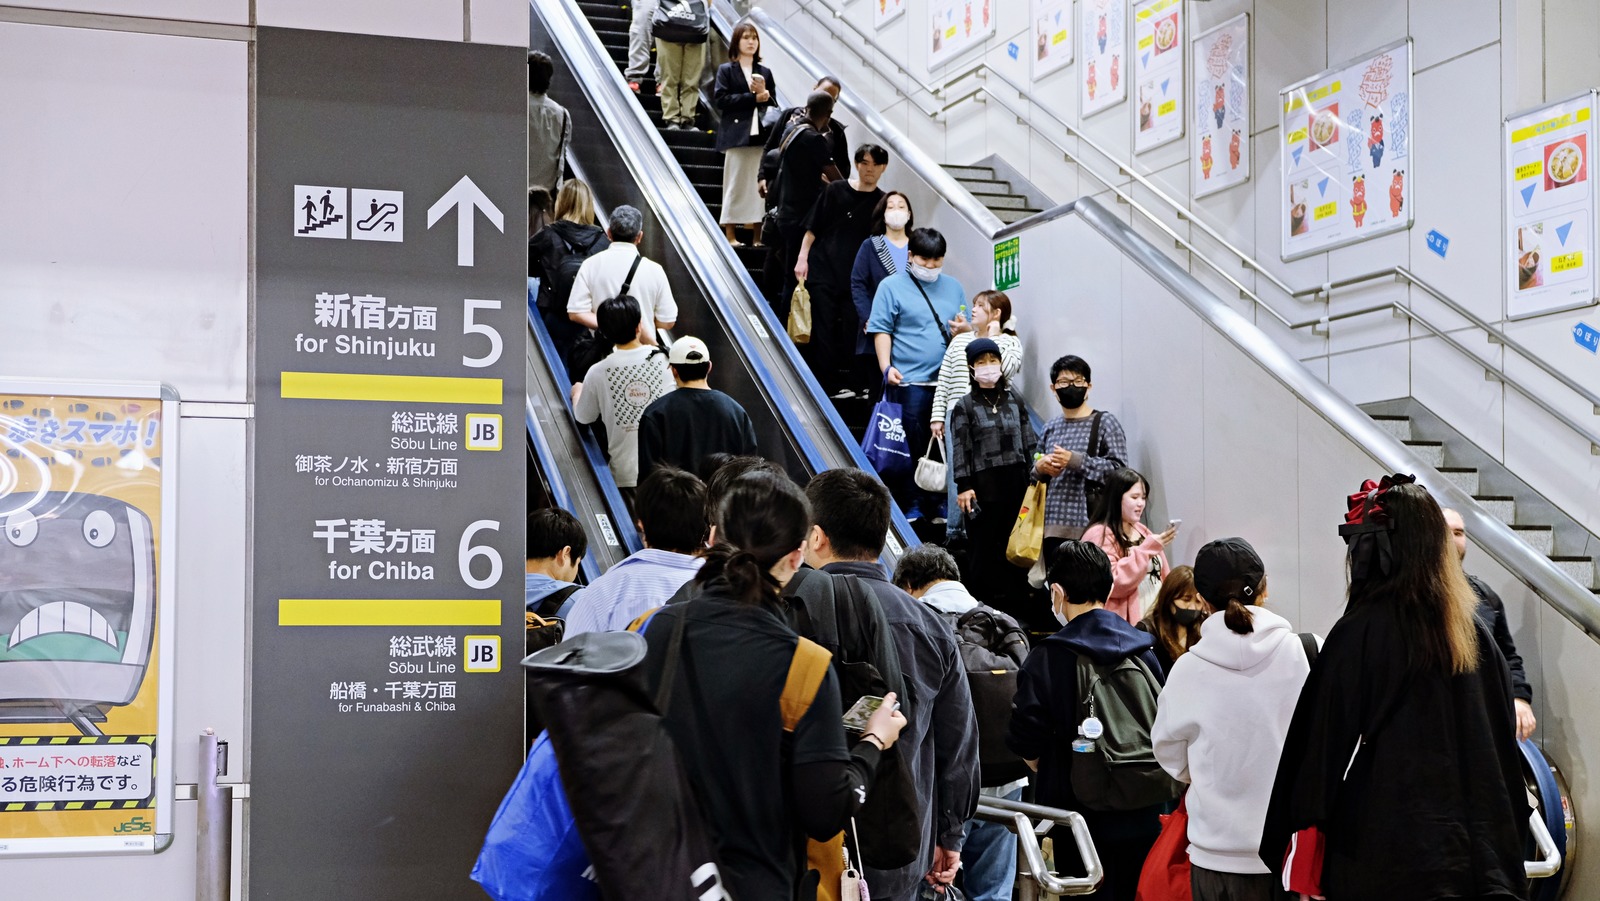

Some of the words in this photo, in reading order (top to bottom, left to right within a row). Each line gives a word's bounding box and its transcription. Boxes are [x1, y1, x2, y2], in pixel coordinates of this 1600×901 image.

[313, 291, 437, 331] 新宿方面
[462, 298, 503, 368] 5
[1576, 327, 1599, 346] のぼり
[295, 333, 328, 353] for
[335, 334, 436, 361] Shinjuku
[391, 411, 458, 435] 総武線
[472, 423, 495, 441] JB
[430, 437, 458, 451] Line
[295, 454, 458, 476] 御茶ノ水・新宿方面
[315, 475, 329, 486] for
[332, 475, 399, 488] Ochanomizu
[402, 477, 410, 488] &
[413, 477, 457, 490] Shinjuku
[312, 518, 436, 555] 千葉方面
[458, 519, 503, 590] 6
[328, 560, 361, 580] for
[368, 560, 435, 581] Chiba
[389, 634, 457, 658] 総武線
[471, 645, 494, 662] JB
[428, 661, 456, 674] Line
[329, 680, 456, 700] 船橋・千葉方面
[338, 702, 353, 712] for
[356, 702, 411, 713] Funabashi
[414, 702, 422, 712] &
[425, 701, 456, 712] Chiba
[1, 774, 138, 793] る危険行為です。
[113, 816, 152, 833] JESS
